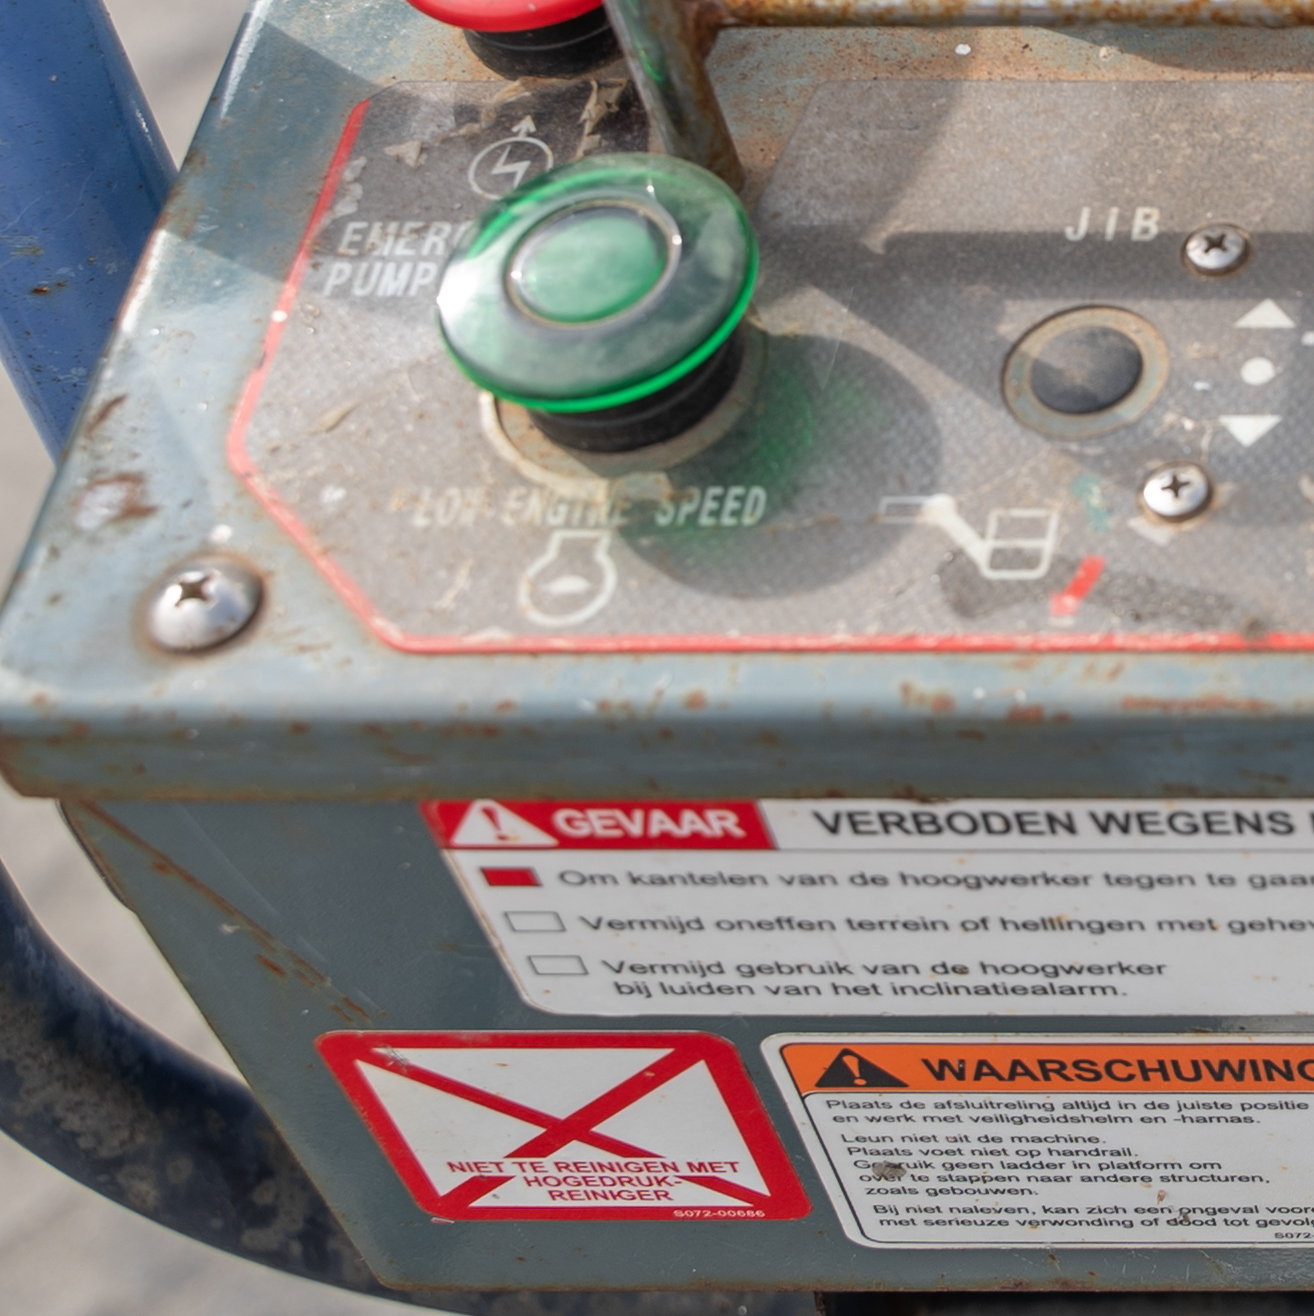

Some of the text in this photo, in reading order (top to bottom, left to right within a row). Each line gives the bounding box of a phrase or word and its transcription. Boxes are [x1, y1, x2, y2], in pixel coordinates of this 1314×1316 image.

[1064, 206, 1161, 241] JIB
[322, 260, 439, 297] PUMP
[654, 485, 768, 528] SPEED
[551, 808, 748, 839] GEVAAR
[812, 810, 1078, 836] VERBODEN
[1088, 810, 1296, 836] WEGENS
[557, 870, 620, 887] Om
[626, 870, 769, 887] kantelen
[778, 874, 839, 887] van
[847, 871, 890, 888] de
[898, 871, 1092, 891] hoogwerker
[1102, 873, 1197, 890] tegen
[1205, 872, 1237, 888] te
[578, 915, 706, 935] Vermijd
[714, 915, 837, 932] oneffen
[844, 916, 951, 932] terrein
[959, 916, 990, 933] of
[998, 915, 1146, 936] hellingen
[1156, 917, 1219, 932] met
[601, 959, 1167, 979] Vermijd gebruik van de hoogwerker
[613, 980, 1127, 999] bij luiden van het inclinatiealarm.
[825, 1099, 1310, 1114] Plaats de afsluitreling altijd in de juiste positie
[832, 1113, 1261, 1126] en werk met veiligheidshelm en -harnas.
[840, 1133, 894, 1144] Leun
[900, 1133, 940, 1144] niet
[976, 1134, 1004, 1144] de
[1010, 1133, 1106, 1144] machine.
[446, 1160, 740, 1174] NIET TE REINIGEN MET
[524, 1174, 683, 1188] HOGEDRUK-
[547, 1189, 674, 1202] REINIGER
